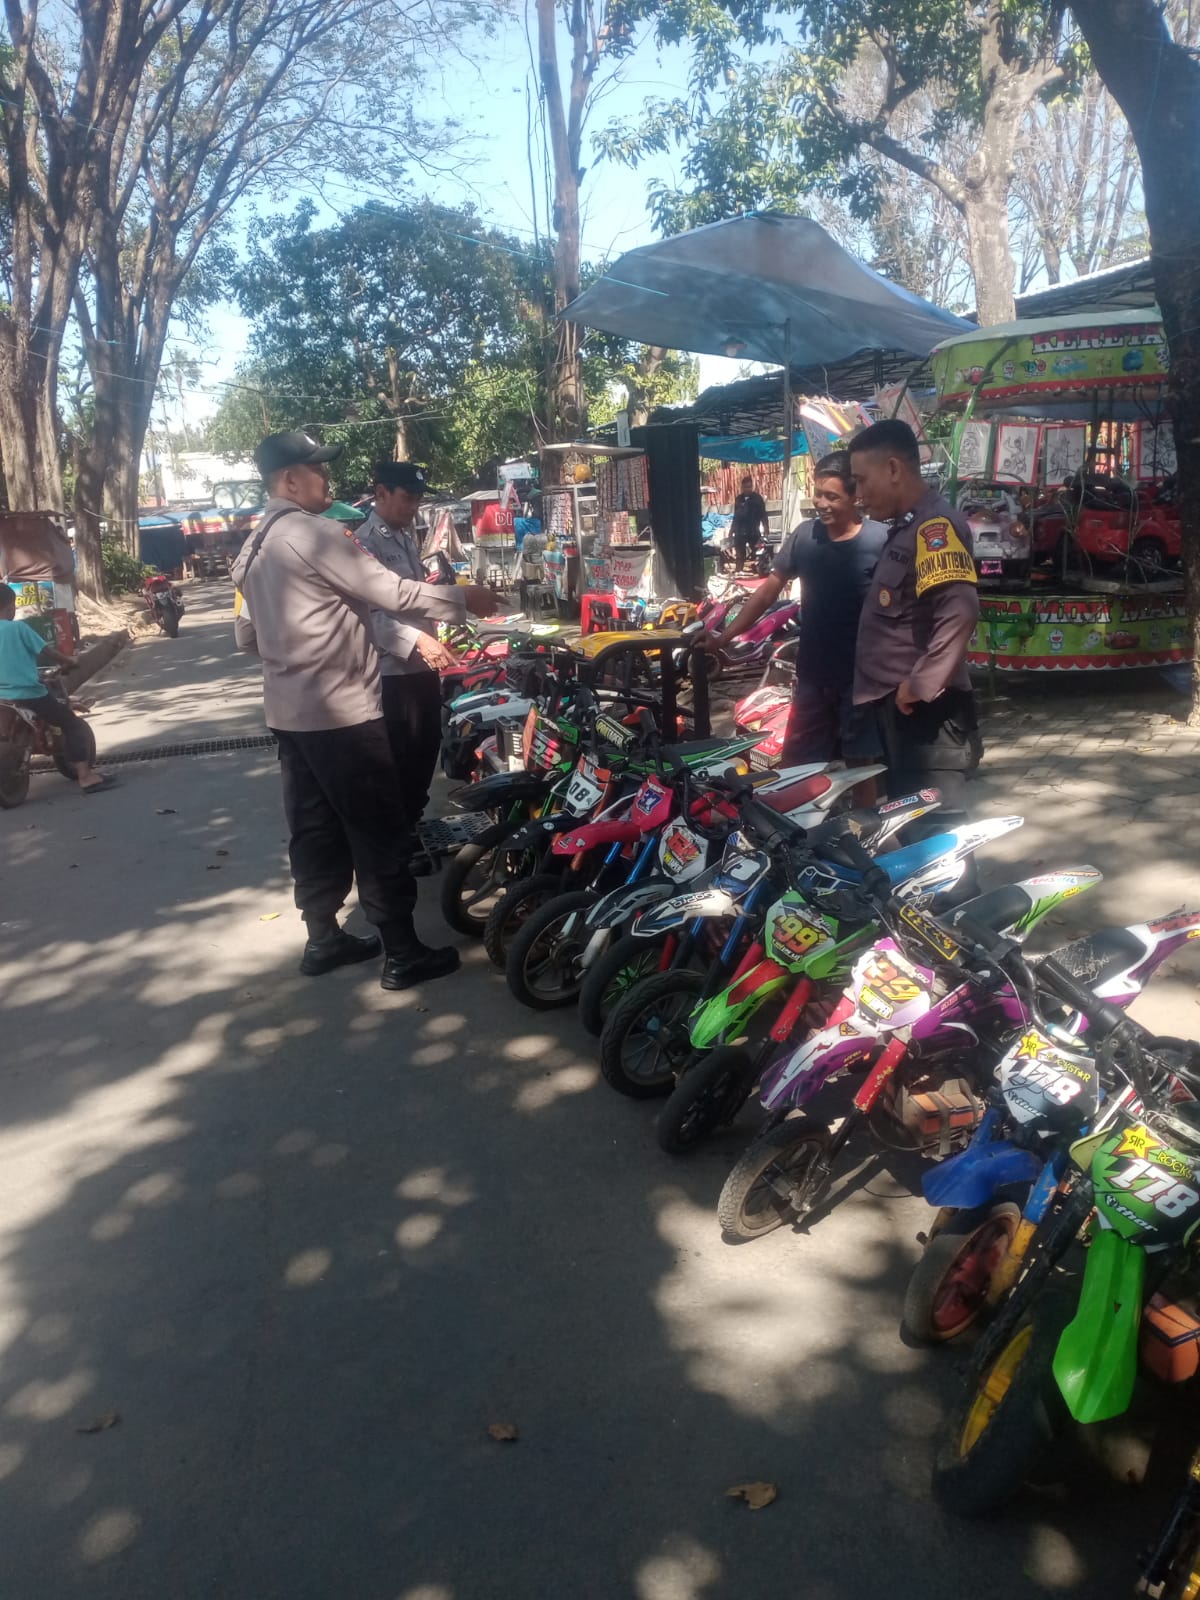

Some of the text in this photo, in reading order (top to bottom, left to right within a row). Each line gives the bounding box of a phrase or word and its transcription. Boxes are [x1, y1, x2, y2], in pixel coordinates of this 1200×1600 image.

[1033, 323, 1164, 354] KERETA
[568, 781, 591, 802] 08
[773, 916, 819, 954] 99
[1108, 1158, 1200, 1218] 178
